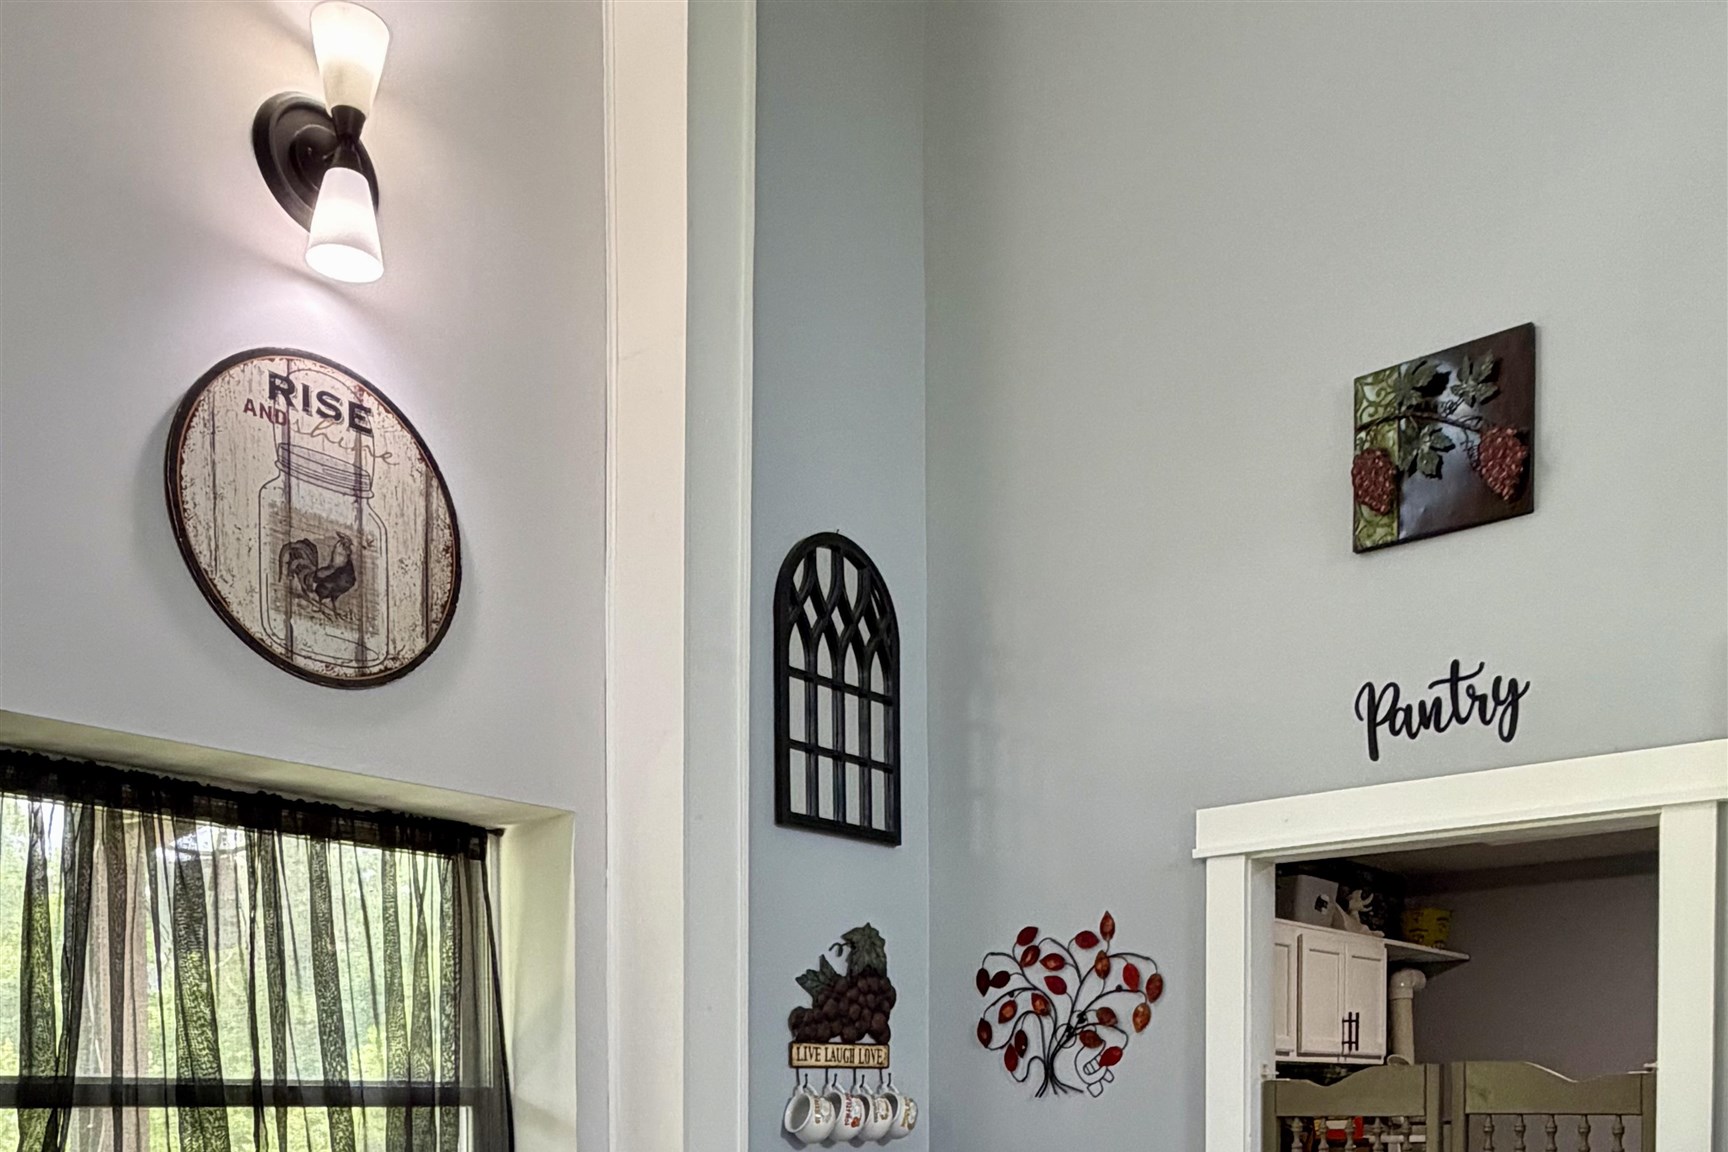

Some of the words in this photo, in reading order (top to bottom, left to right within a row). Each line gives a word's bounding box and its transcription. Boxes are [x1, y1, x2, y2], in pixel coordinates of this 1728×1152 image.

[243, 397, 287, 426] AND
[290, 417, 400, 466] shine
[268, 371, 374, 438] RISE
[1354, 658, 1531, 762] Pantry
[796, 1045, 822, 1062] LIVE
[824, 1046, 855, 1063] LAUGH
[858, 1047, 884, 1065] LOVE
